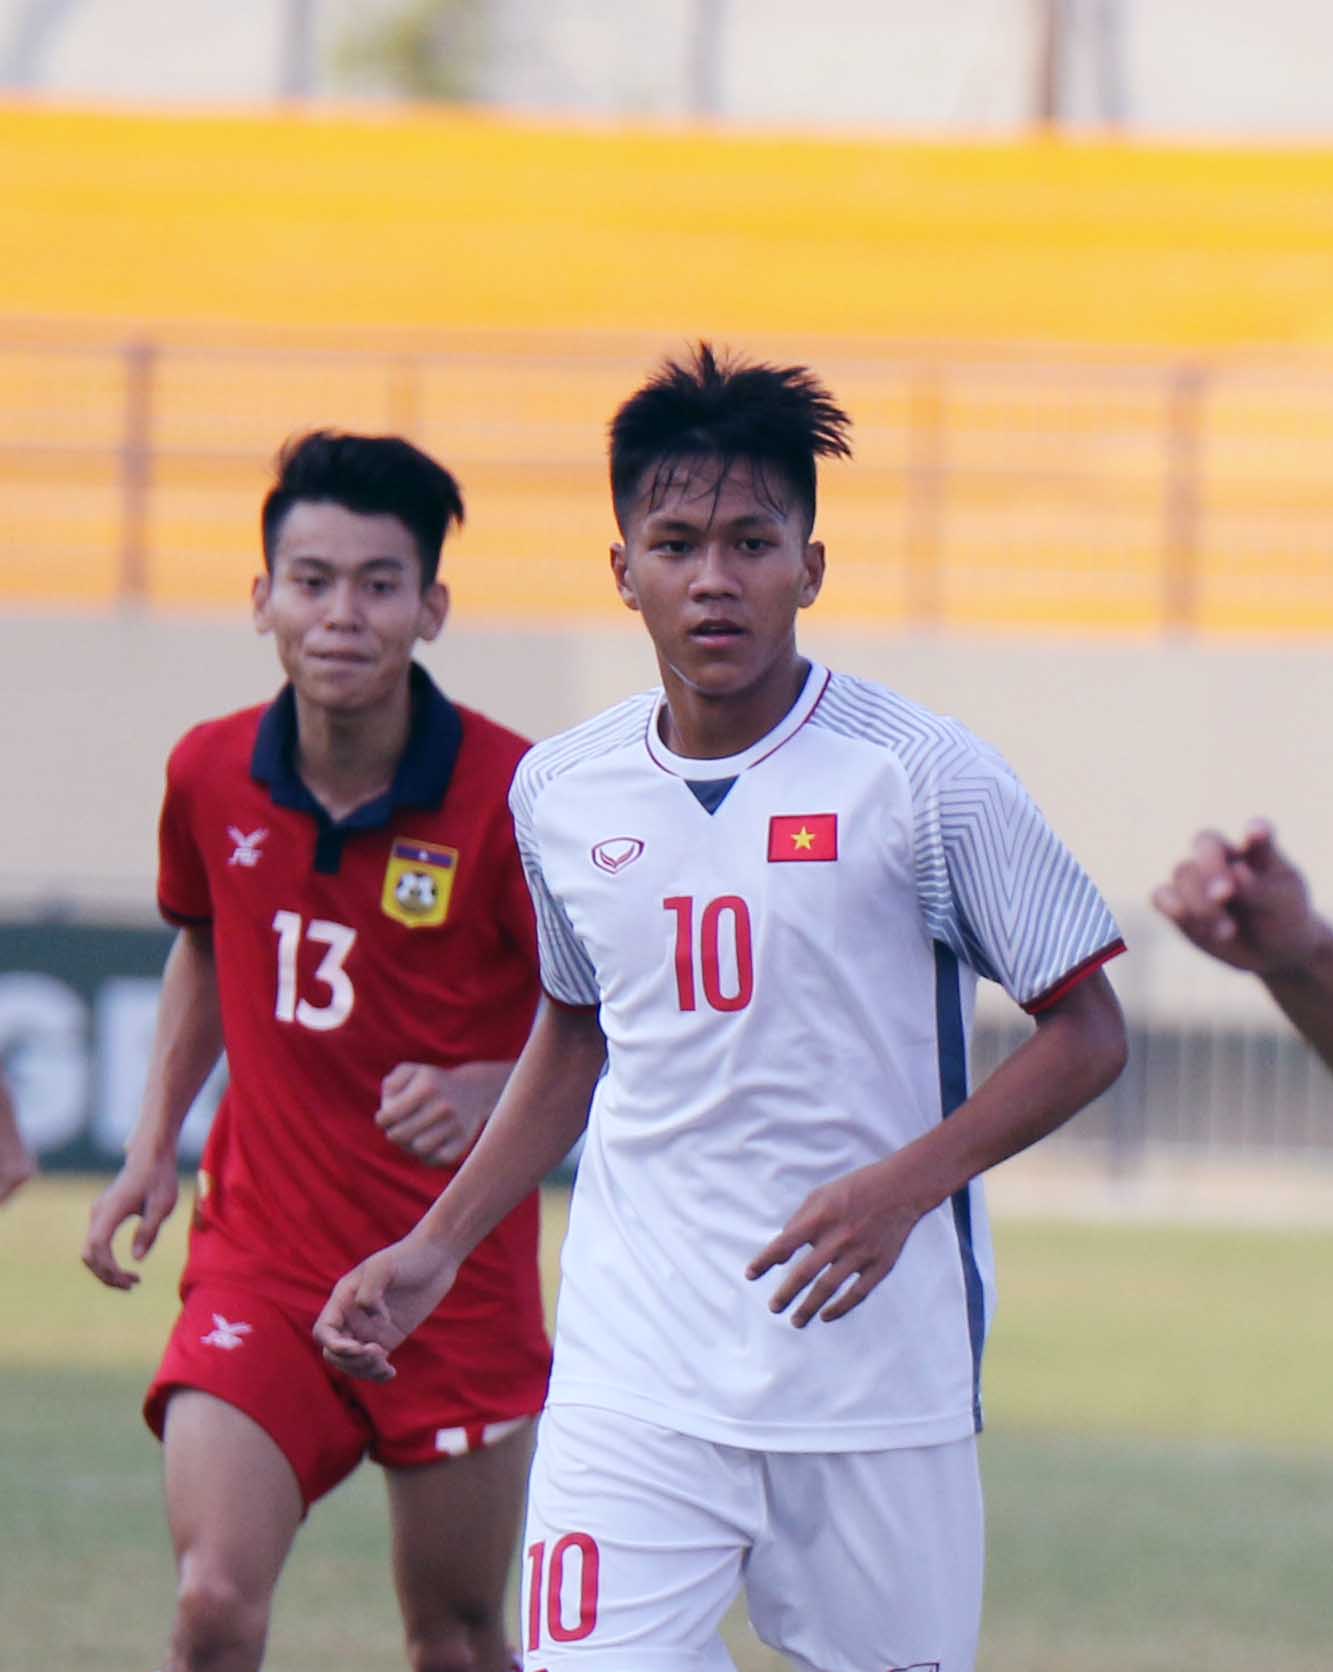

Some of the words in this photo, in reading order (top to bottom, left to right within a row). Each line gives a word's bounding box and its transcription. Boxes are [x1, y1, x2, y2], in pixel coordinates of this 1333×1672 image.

[272, 909, 358, 1032] 13
[663, 895, 755, 1013] 10
[528, 1531, 600, 1653] 10
